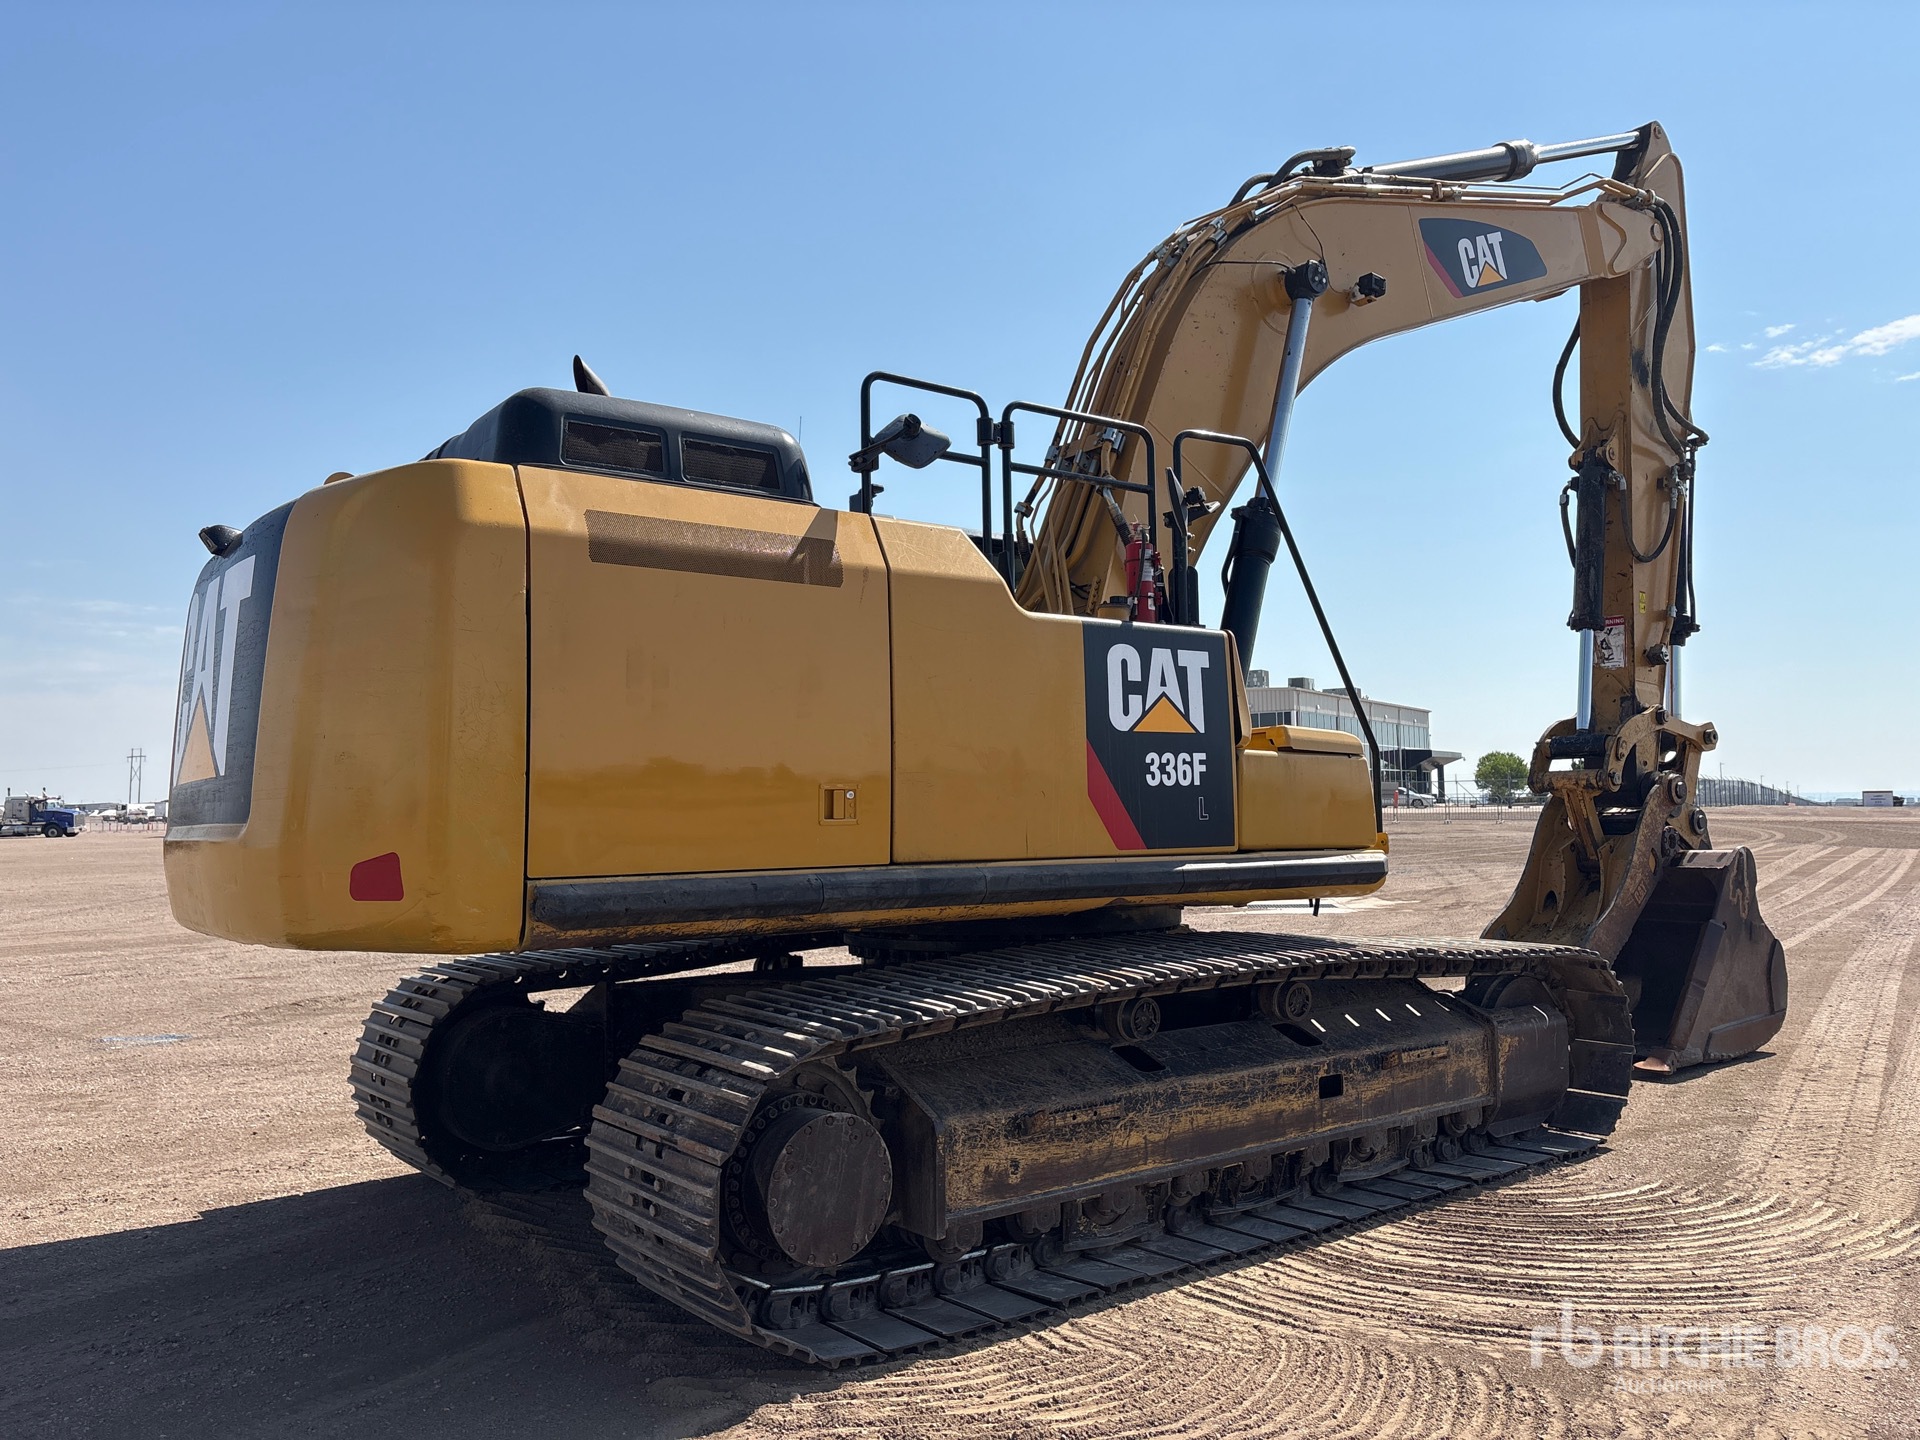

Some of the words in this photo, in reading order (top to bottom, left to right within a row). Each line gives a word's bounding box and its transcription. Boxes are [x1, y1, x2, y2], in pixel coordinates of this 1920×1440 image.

[1457, 231, 1508, 288] CAT
[172, 554, 256, 788] CAT
[1107, 643, 1210, 733] CAT
[1145, 752, 1207, 787] 336F
[1198, 796, 1210, 821] L
